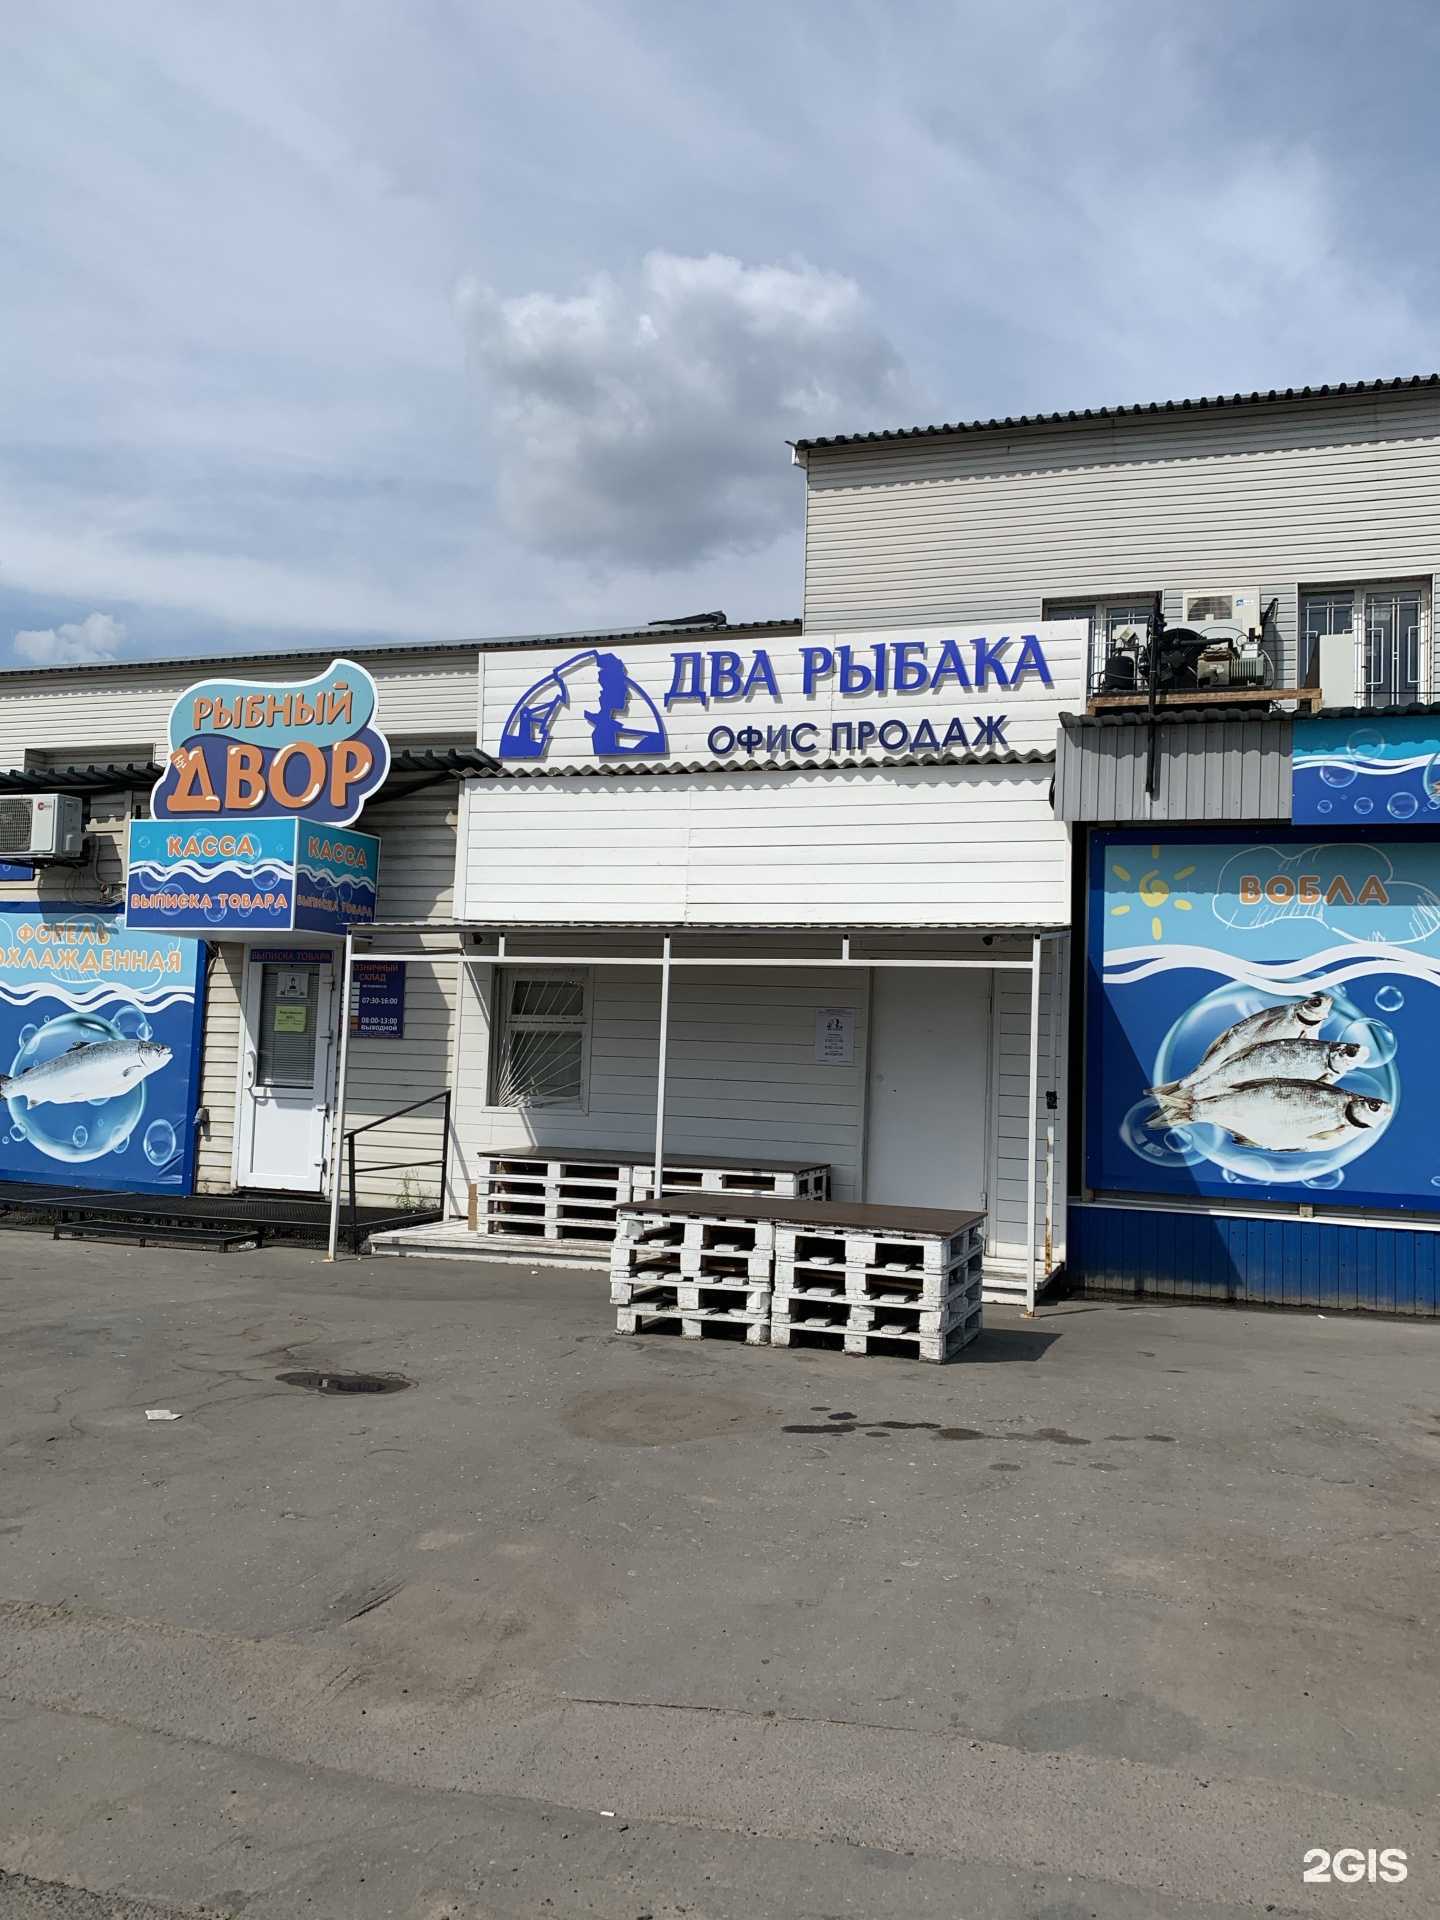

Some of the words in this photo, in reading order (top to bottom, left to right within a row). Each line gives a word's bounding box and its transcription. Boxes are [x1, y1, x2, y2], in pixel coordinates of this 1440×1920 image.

[664, 649, 779, 707] ДВА
[799, 635, 1054, 695] РЫБАКА
[193, 682, 353, 730] РЫБНЫЙ
[708, 722, 817, 755] ОФИС
[831, 715, 1007, 753] ПРОДАЖ
[167, 740, 373, 812] ДВОР
[167, 835, 254, 857] КАССА
[308, 836, 367, 868] КАССА
[131, 893, 212, 909] ВЫПИСКА
[218, 893, 288, 909] ТОВАРА
[1240, 875, 1389, 905] ВОБЛА
[16, 922, 111, 945] ФОРЕЛЬ
